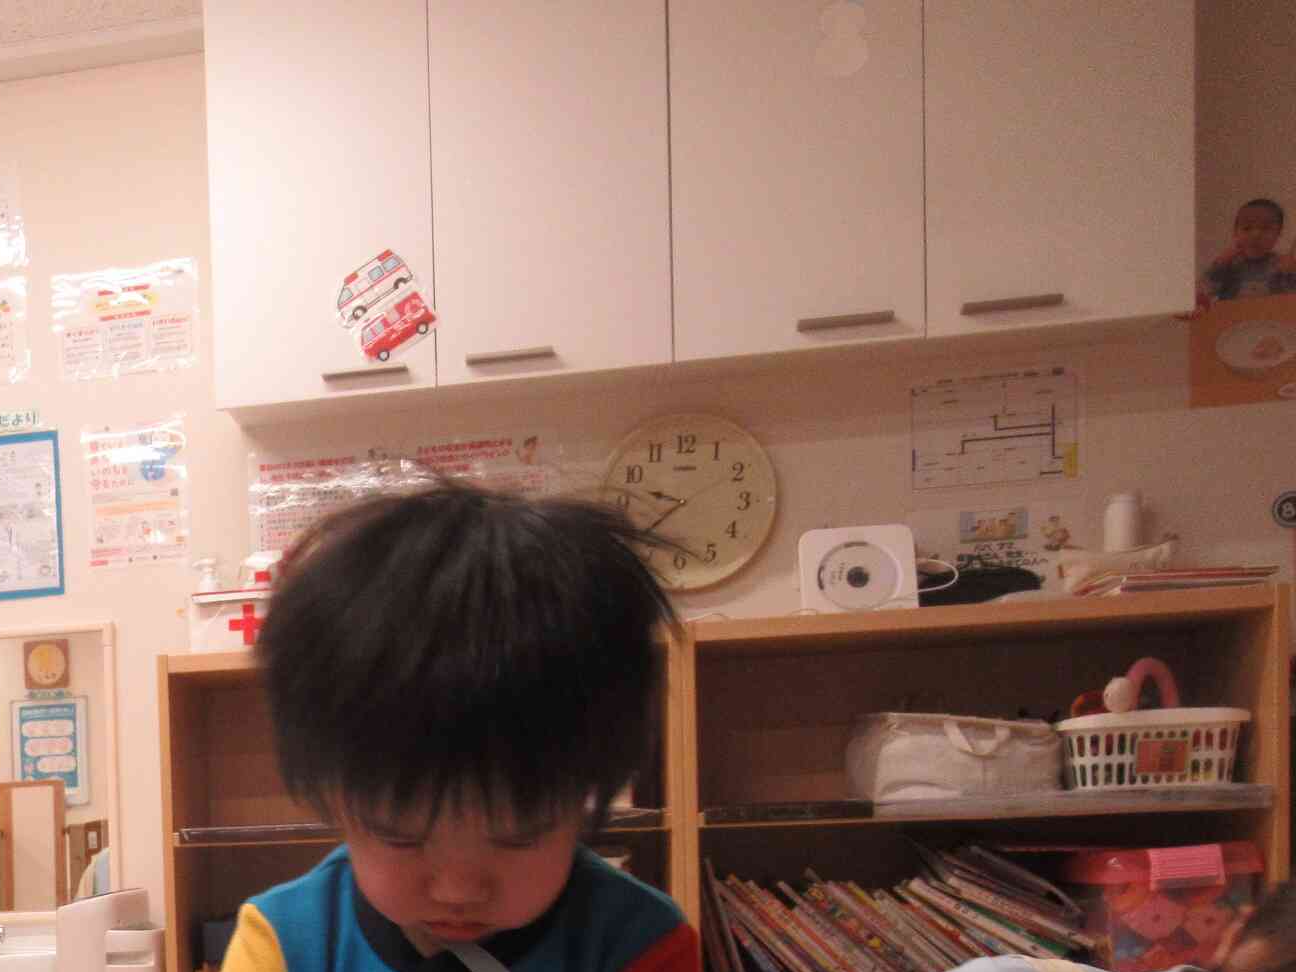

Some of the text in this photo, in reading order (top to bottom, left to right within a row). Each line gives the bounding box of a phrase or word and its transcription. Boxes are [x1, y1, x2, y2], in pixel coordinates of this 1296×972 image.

[648, 441, 662, 462] 11
[675, 434, 696, 454] 12
[711, 441, 721, 461] 1
[625, 464, 643, 483] 10
[732, 462, 745, 481] 2
[737, 491, 751, 511] 3
[725, 520, 738, 539] 4
[673, 550, 687, 570] 6
[704, 544, 717, 563] 5
